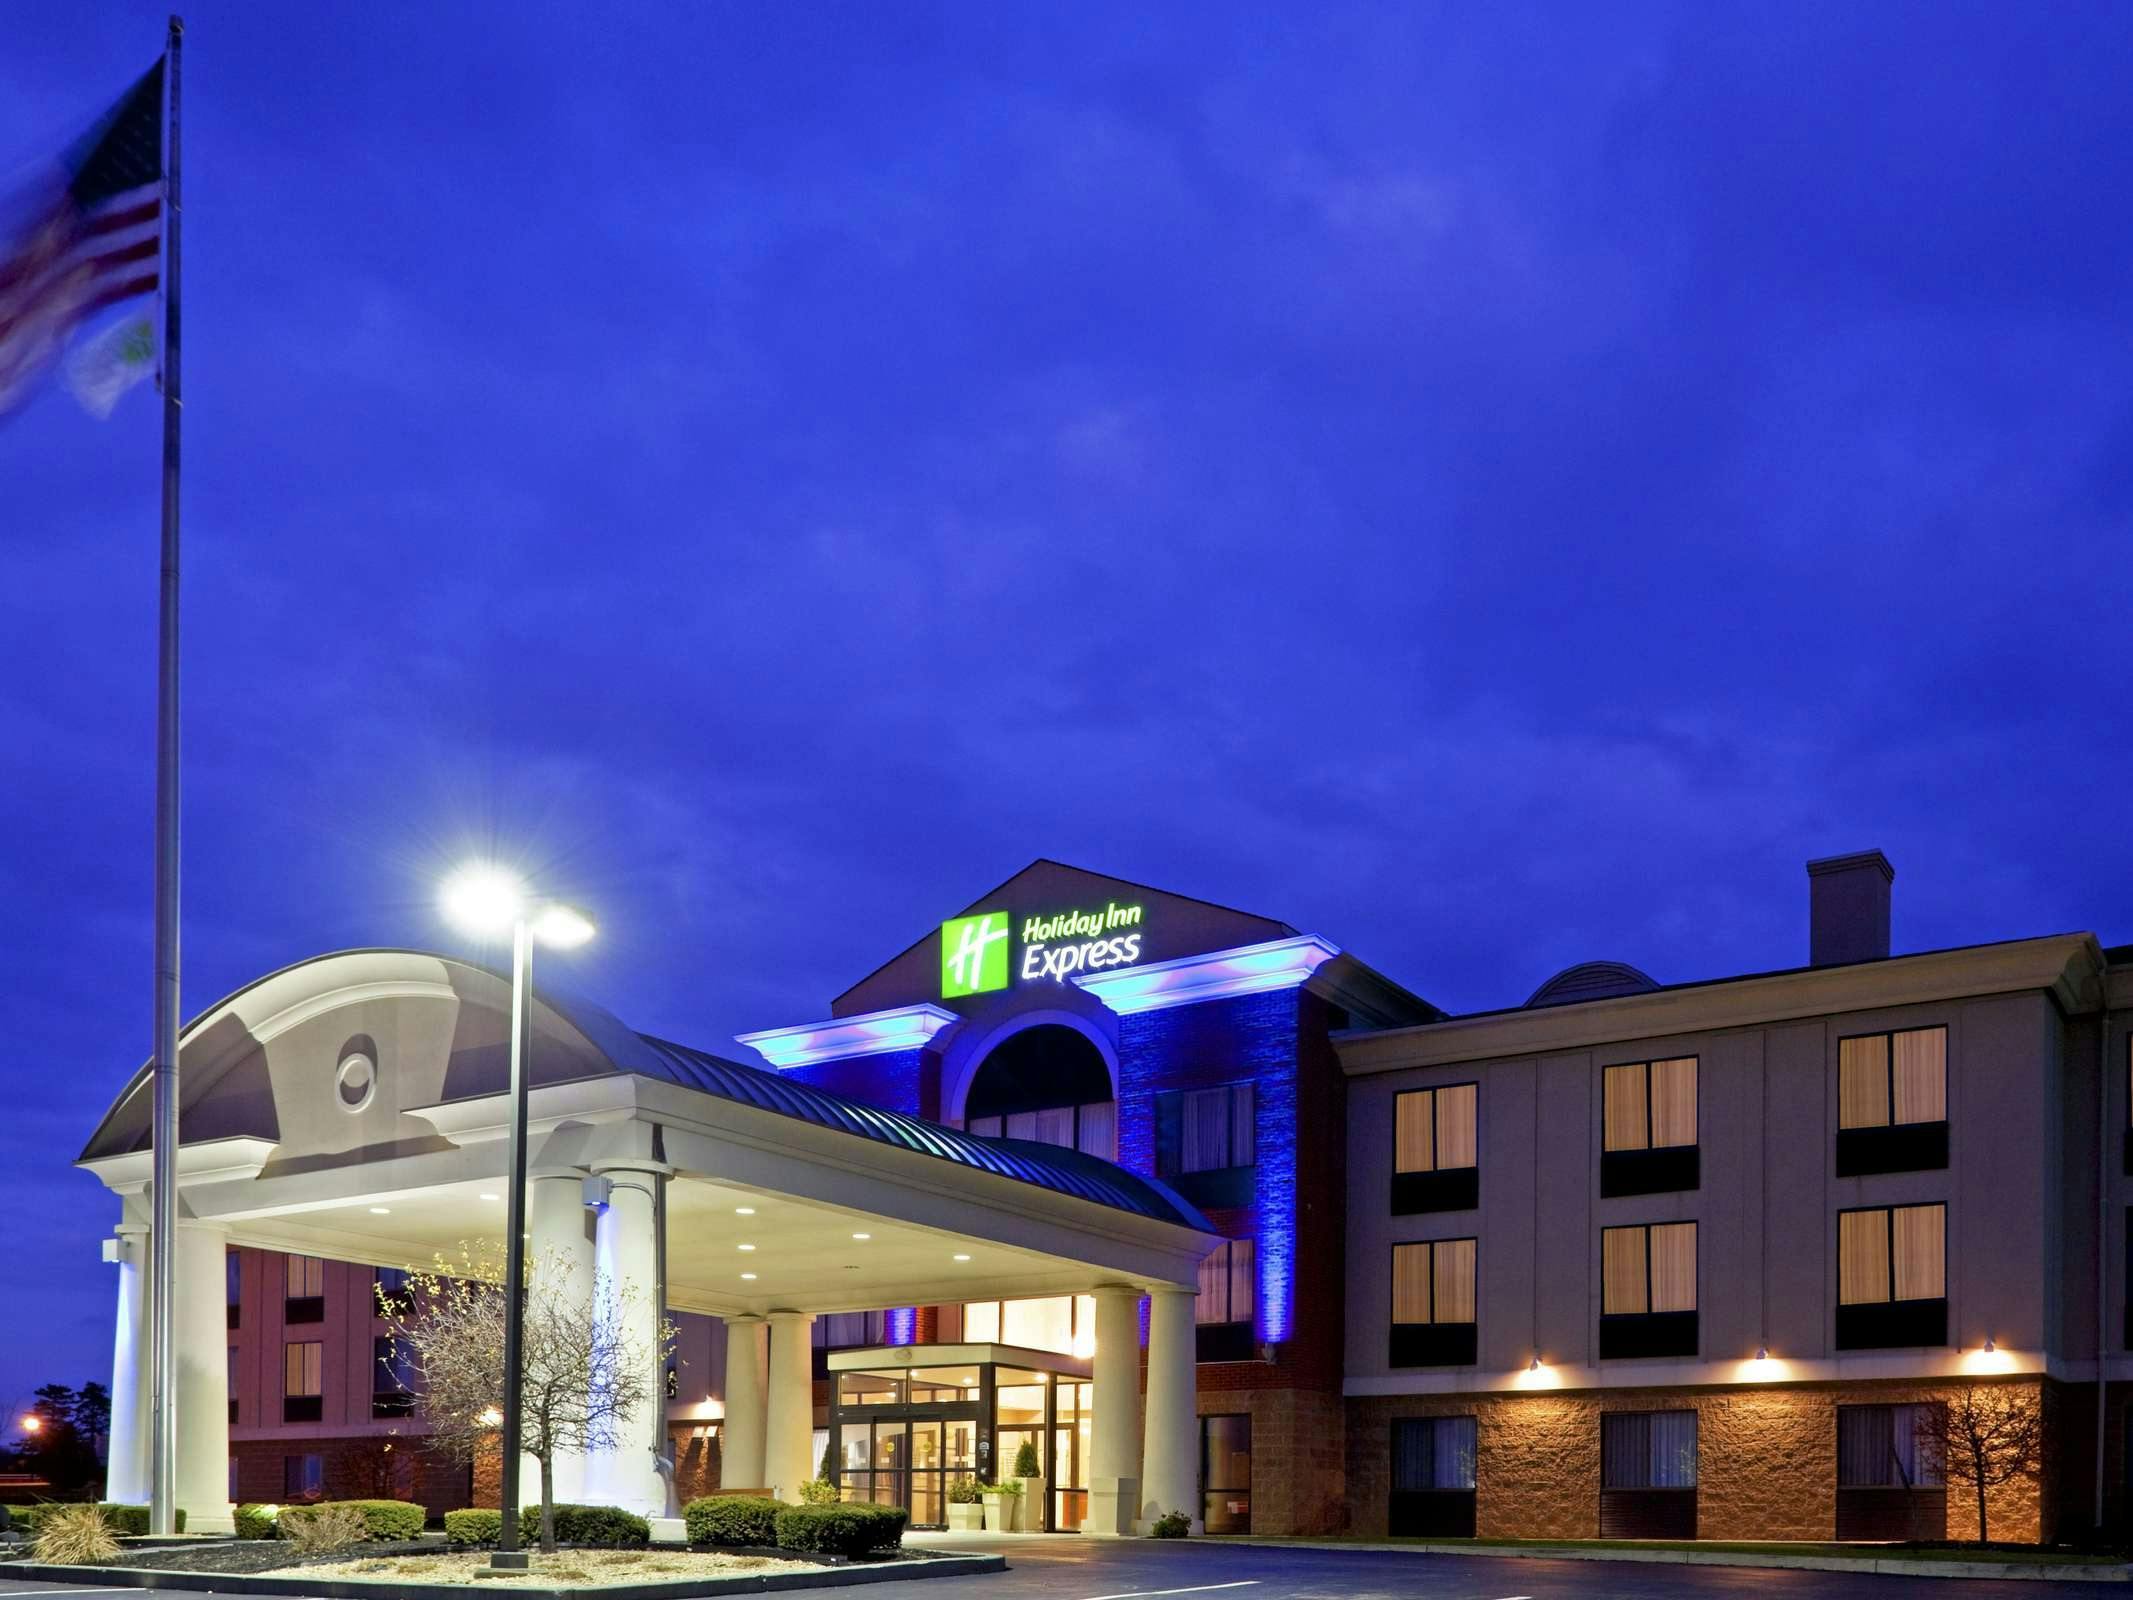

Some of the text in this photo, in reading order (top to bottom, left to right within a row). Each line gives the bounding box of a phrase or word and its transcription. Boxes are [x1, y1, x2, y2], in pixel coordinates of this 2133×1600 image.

[1022, 903, 1141, 943] Holiday Inn
[1022, 933, 1141, 982] Express
